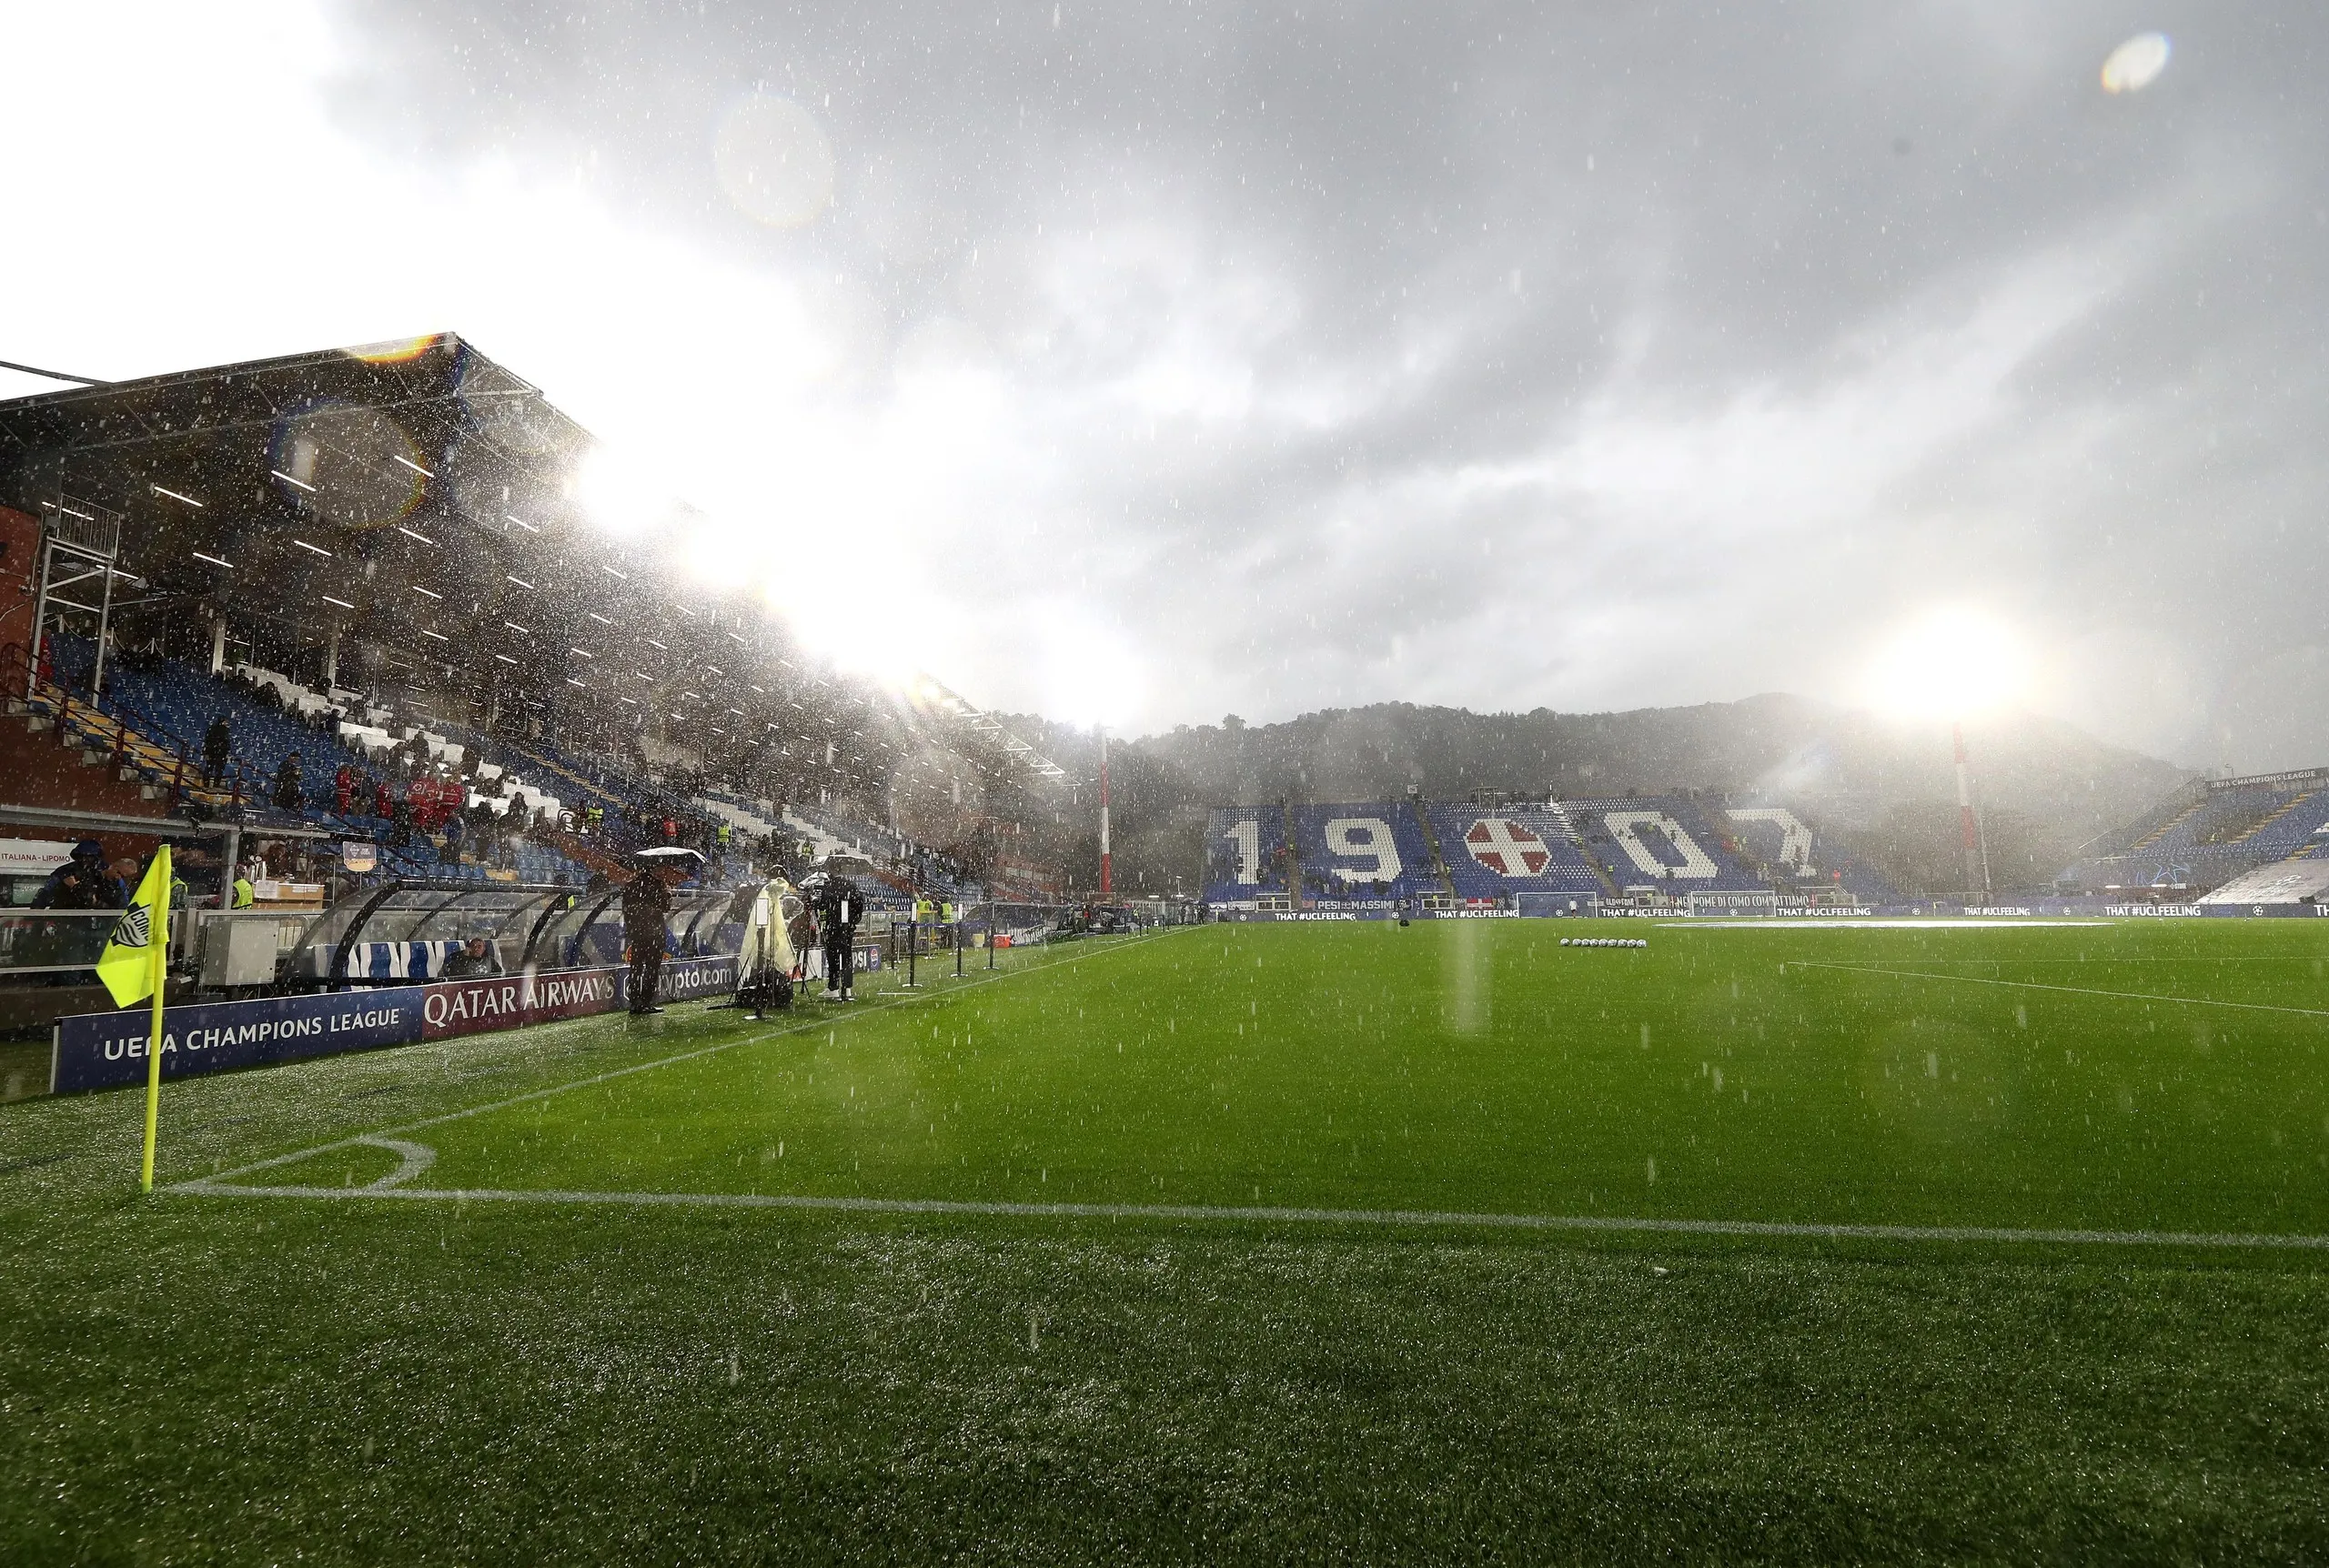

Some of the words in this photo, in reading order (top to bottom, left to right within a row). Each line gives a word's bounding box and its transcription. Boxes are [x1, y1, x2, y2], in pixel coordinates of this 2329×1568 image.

[2210, 780, 2231, 789] UEFA
[2232, 773, 2281, 786] CHAMPIONS
[2282, 769, 2316, 780] LEAGUE
[1, 852, 36, 861] ITALIANA
[1318, 900, 1341, 910] PESI
[1351, 900, 1395, 910] MASSIMI
[1728, 895, 1750, 908] COMO
[1434, 910, 1457, 919] THAT
[1459, 910, 1519, 919] #UCLFEELING
[1601, 909, 1626, 917] THAT
[1628, 909, 1690, 918] #UCLFEELING
[1777, 908, 1803, 917] THAT
[1805, 908, 1871, 917] #UCLFEELING
[1963, 907, 1981, 916] THAT
[1982, 907, 2031, 917] #UCLFEELING
[2103, 906, 2130, 916] THAT
[2132, 905, 2202, 916] #UCLFEELING
[1275, 912, 1297, 921] THAT
[1298, 911, 1356, 921] #UCLFEELING
[852, 950, 867, 969] PSI
[658, 967, 732, 998] rypto.com
[424, 986, 517, 1028] QATAR
[523, 975, 615, 1011] AIRWAYS
[186, 1016, 323, 1051] CHAMPIONS
[329, 1008, 401, 1033] LEAGUE
